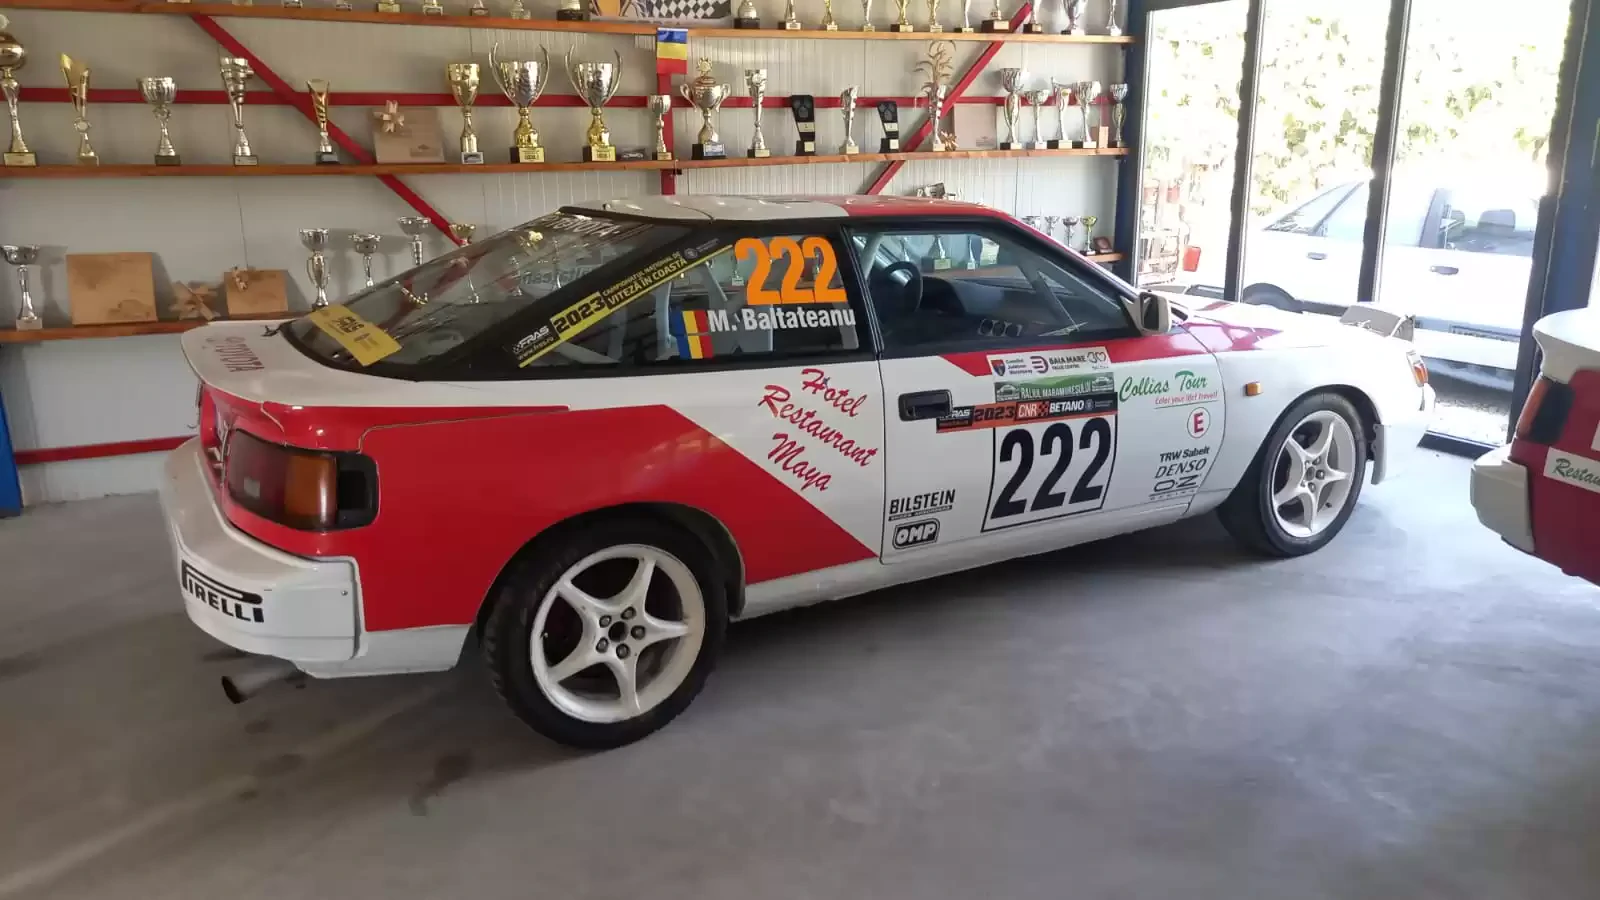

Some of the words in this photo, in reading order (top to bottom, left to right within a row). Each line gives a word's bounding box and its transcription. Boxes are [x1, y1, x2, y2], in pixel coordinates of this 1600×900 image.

[608, 280, 641, 305] VITEZĂ
[641, 274, 653, 289] ÎN
[652, 258, 688, 284] COASTĂ
[735, 236, 848, 305] 222
[553, 296, 604, 333] 2023
[707, 310, 737, 332] M.
[741, 307, 856, 331] Baltateanu
[519, 325, 550, 348] FRAS
[1049, 356, 1066, 365] BAIA
[1066, 355, 1086, 364] MARE
[802, 368, 867, 417] Hotel
[1119, 377, 1170, 402] Collias
[1174, 371, 1207, 392] Tour
[975, 406, 1016, 422] 2023
[1018, 401, 1038, 418] CNR
[1049, 400, 1084, 413] BETANO
[1193, 412, 1204, 433] E
[758, 385, 878, 466] Restaurant
[768, 433, 832, 491] Maya
[990, 417, 1112, 519] 222
[1155, 458, 1207, 479] DENSO
[1160, 450, 1182, 462] TRW
[889, 489, 956, 515] BILSTEIN
[896, 523, 937, 545] OMP
[181, 559, 264, 623] PIRELLI
